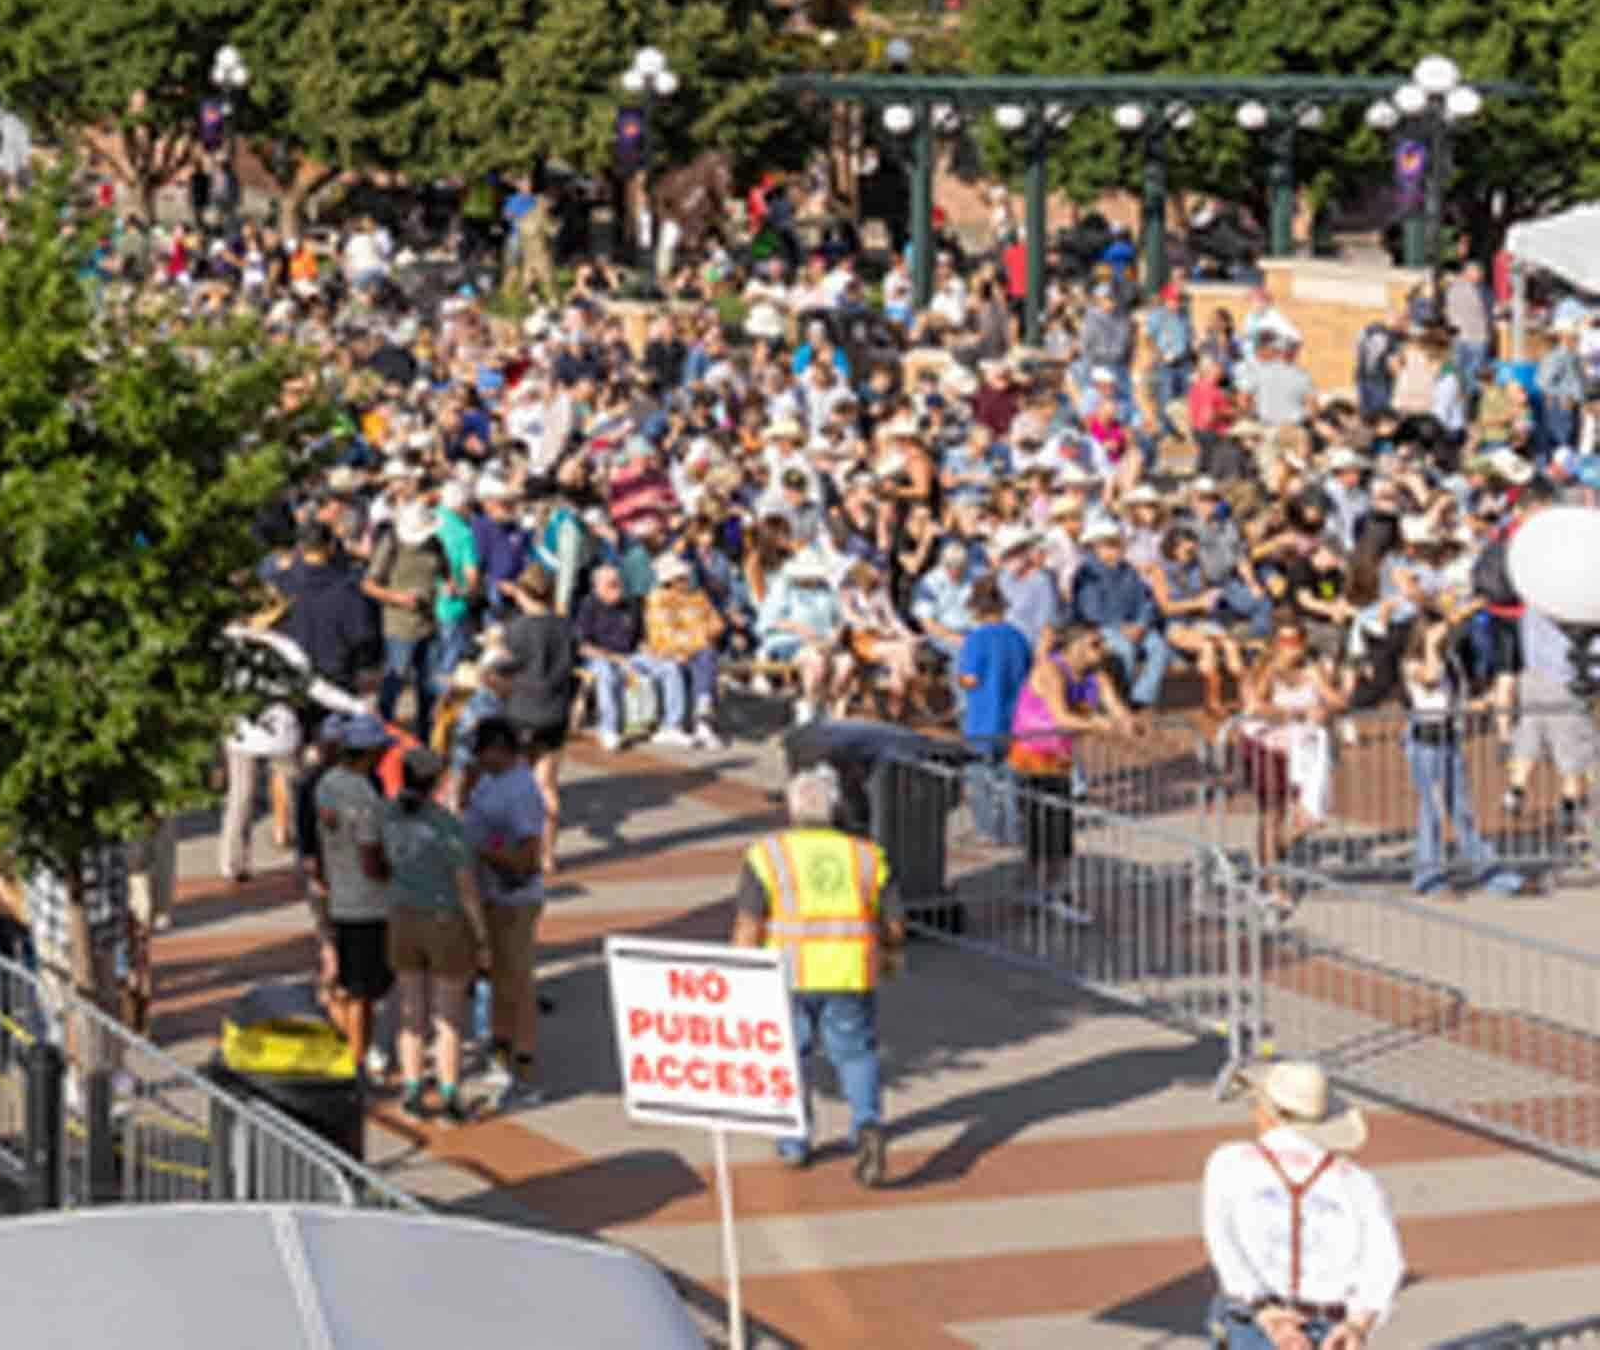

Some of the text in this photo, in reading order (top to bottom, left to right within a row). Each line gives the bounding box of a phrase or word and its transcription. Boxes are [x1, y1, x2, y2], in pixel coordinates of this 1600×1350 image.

[667, 969, 729, 1003] NO
[628, 1008, 783, 1053] PUBLIC
[630, 1053, 794, 1103] ACCESS
